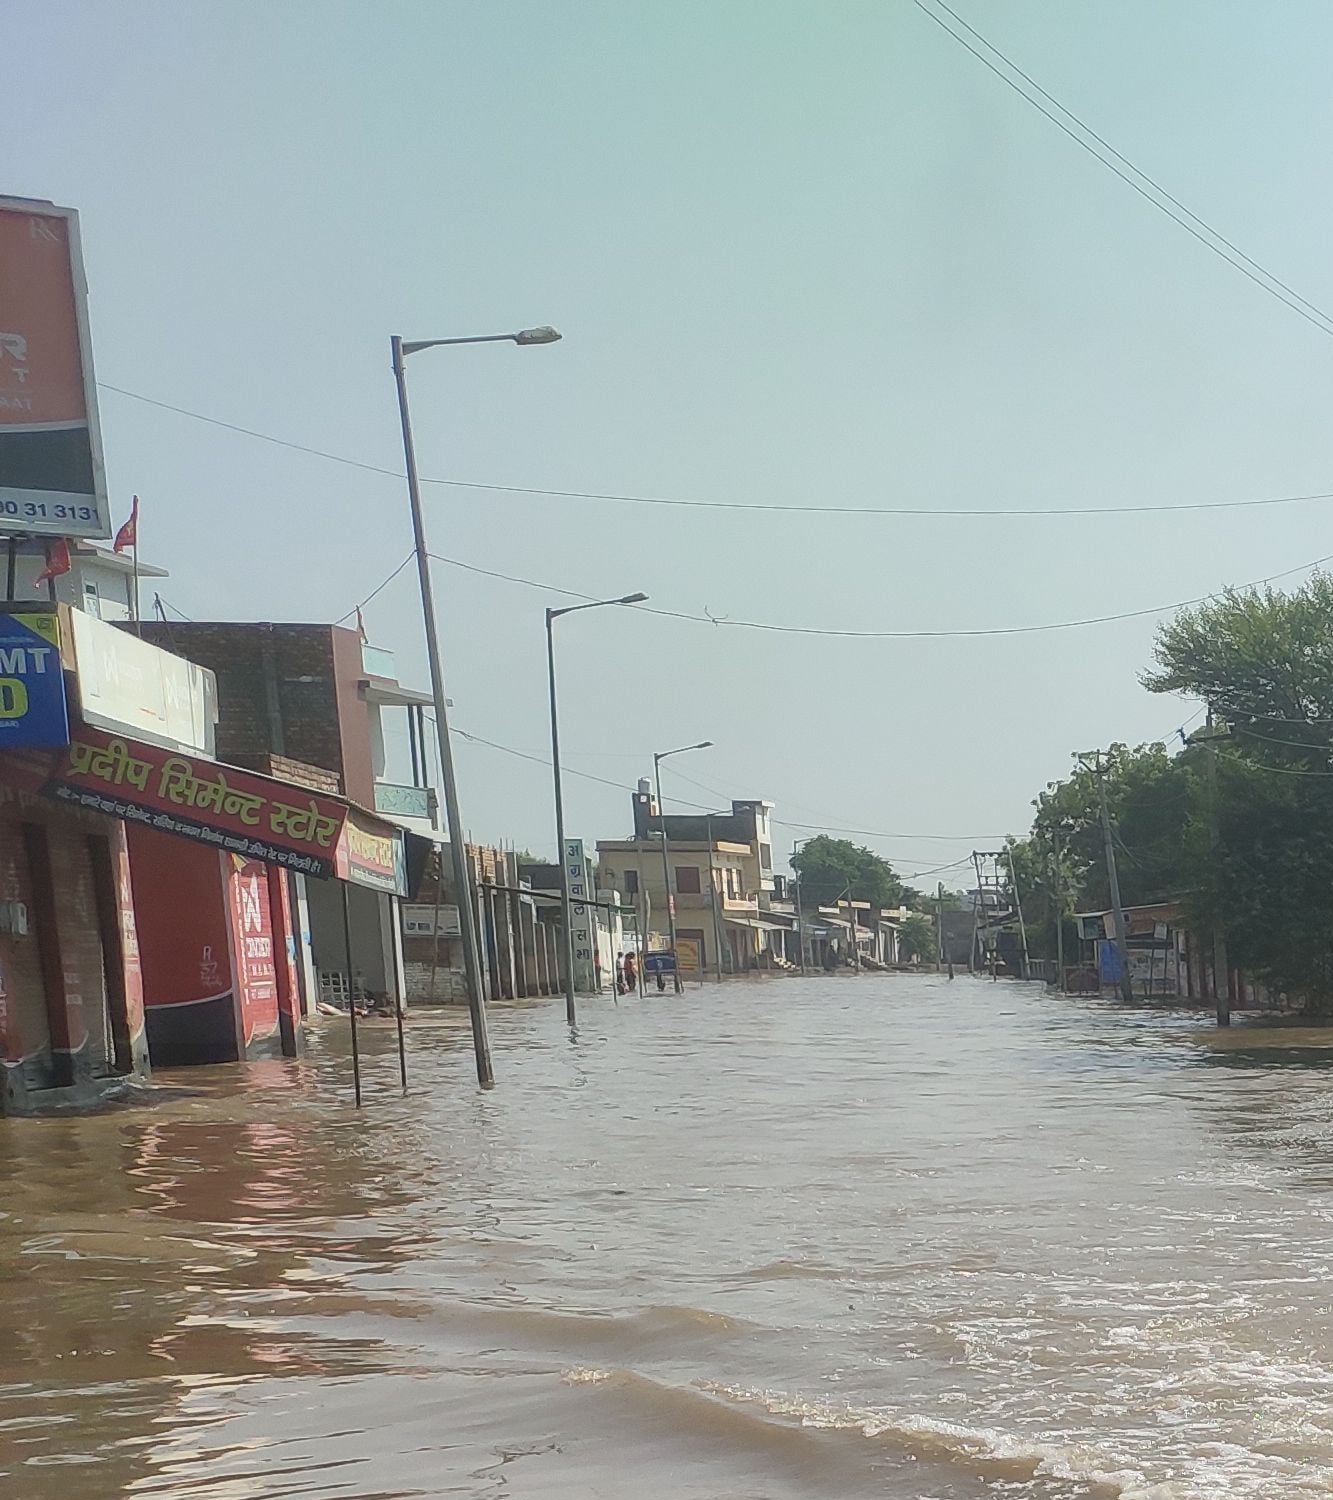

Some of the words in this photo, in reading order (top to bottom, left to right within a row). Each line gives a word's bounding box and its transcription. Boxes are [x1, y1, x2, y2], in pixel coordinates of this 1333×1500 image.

[25, 503, 47, 517] 31
[54, 505, 99, 520] 3131
[66, 739, 154, 792] प्रदीप
[158, 757, 267, 826] सिमेन्ट
[269, 800, 339, 847] स्टोर
